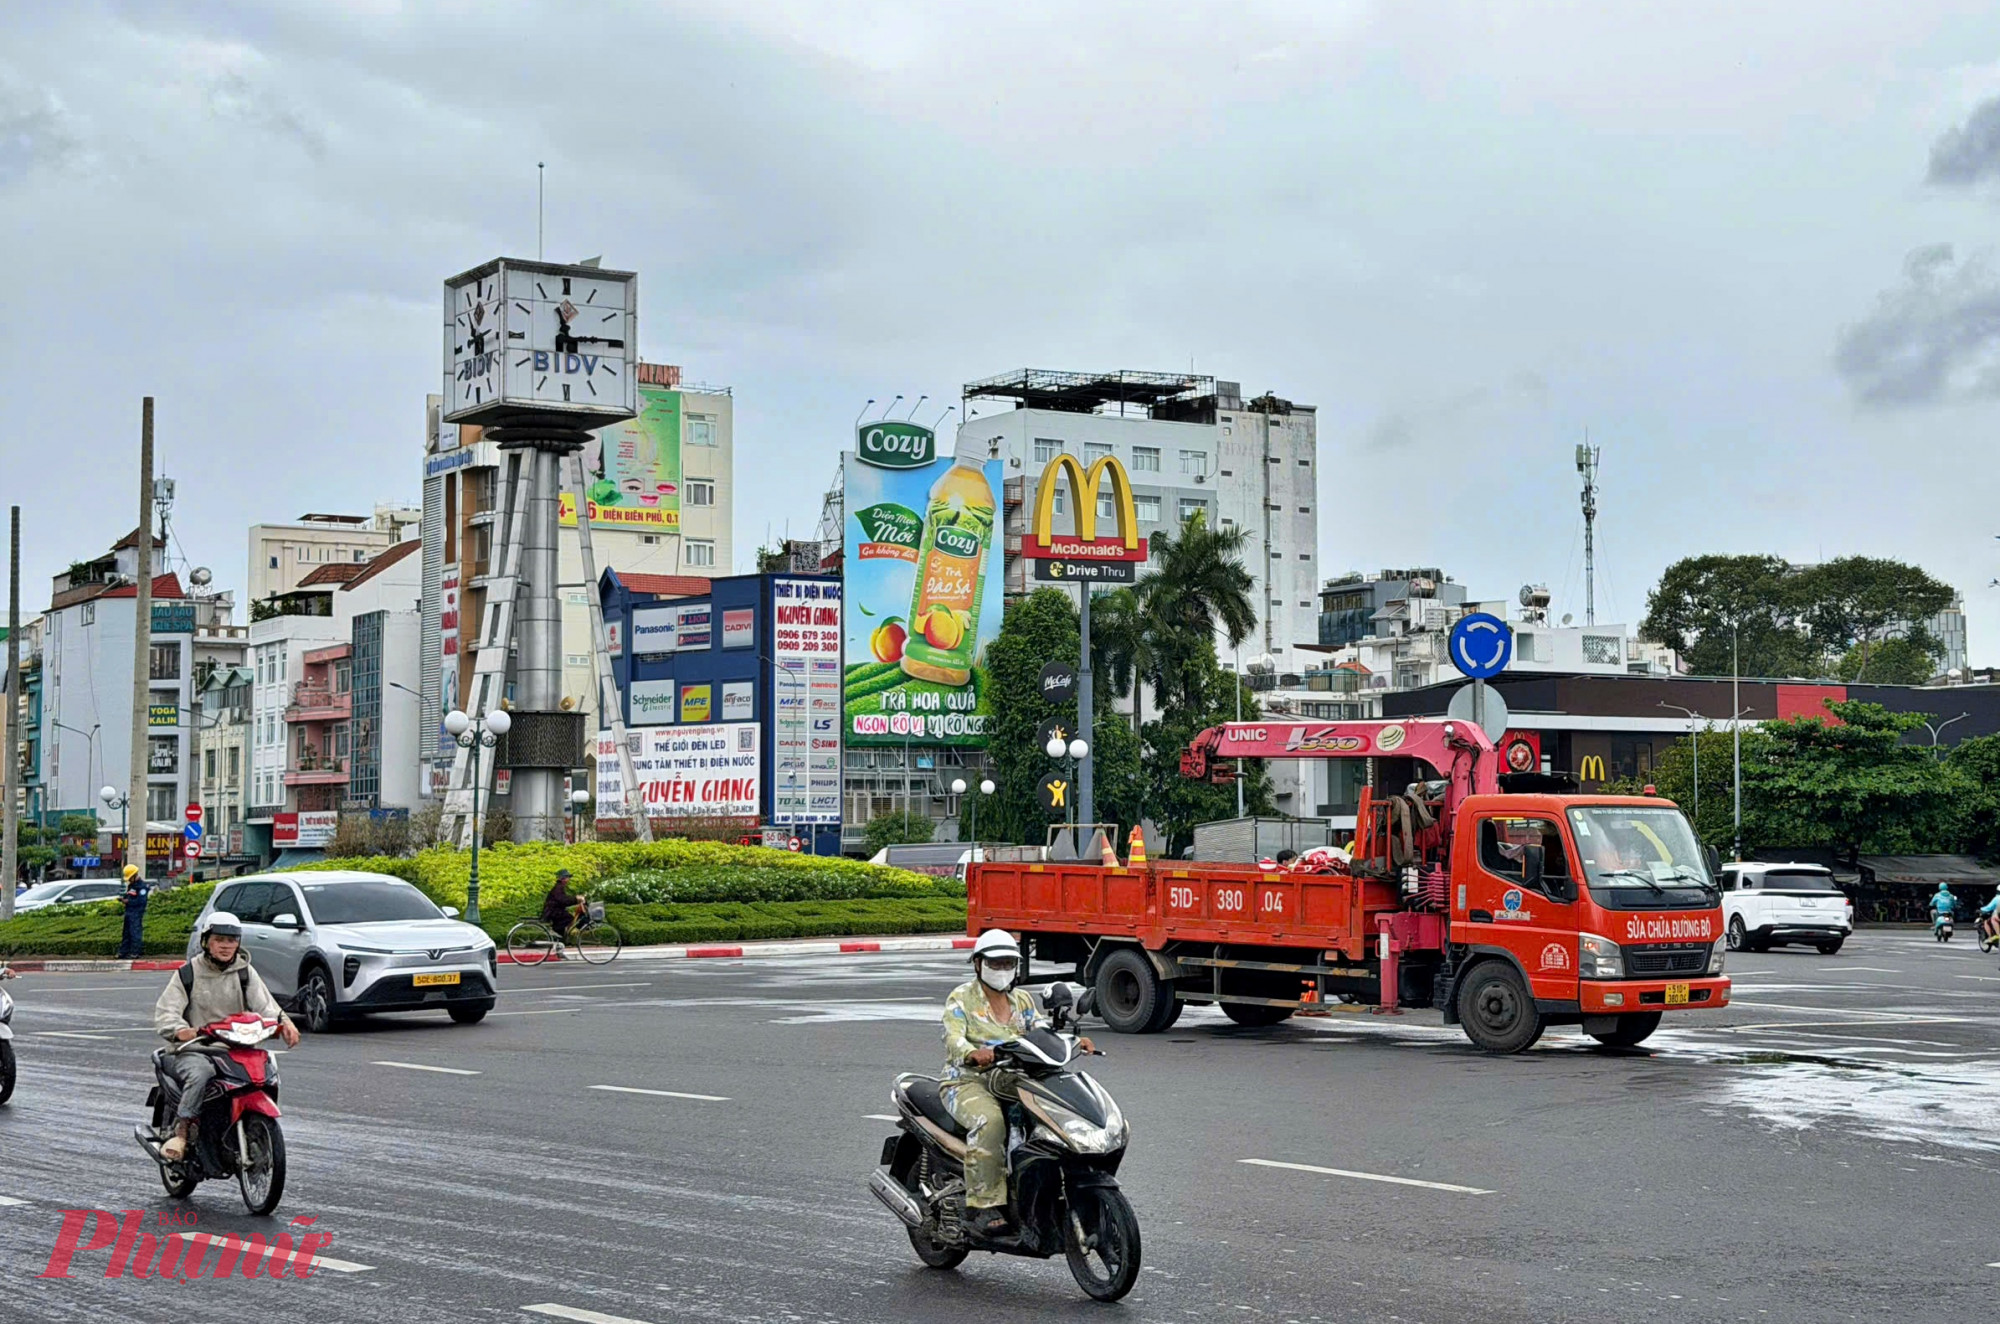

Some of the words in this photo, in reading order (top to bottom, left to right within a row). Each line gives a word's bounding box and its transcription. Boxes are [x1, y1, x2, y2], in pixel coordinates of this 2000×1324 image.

[464, 351, 494, 381] BIDV
[534, 351, 599, 376] BIDV
[866, 429, 927, 459] Cozy
[603, 507, 622, 524] ĐIỆN
[625, 509, 643, 521] BIÊN
[666, 511, 678, 523] Q.1
[872, 508, 894, 520] Diện
[874, 521, 916, 543] Mới
[937, 530, 977, 554] Cozy
[1051, 543, 1124, 556] McDonald's
[1067, 565, 1098, 576] Drive
[1101, 566, 1125, 577] Thru
[927, 577, 953, 594] Đào
[814, 607, 838, 626] GIANG
[635, 622, 675, 634] Panasonic
[725, 623, 751, 632] CADIVI
[777, 630, 799, 640] 0906
[802, 631, 818, 640] 679
[821, 631, 838, 641] 300
[777, 640, 799, 651] 0909
[802, 641, 819, 652] 209
[821, 642, 838, 652] 300
[633, 693, 672, 706] Schneider
[684, 697, 707, 706] MPE
[881, 686, 906, 710] TRÀ
[912, 692, 940, 710] HOA
[947, 685, 976, 710] QUẢ
[151, 707, 176, 715] YOGA
[149, 716, 177, 724] KALIN
[814, 719, 834, 730] LS
[856, 716, 887, 733] NGON
[892, 714, 908, 731] RÕ
[1228, 728, 1267, 742] UNIC
[655, 739, 670, 752] THẾ
[692, 738, 708, 751] ĐÈN
[711, 740, 726, 750] LED
[631, 759, 652, 770] RUNG
[674, 754, 697, 770] THIẾT
[710, 756, 730, 770] ĐIỆN
[732, 753, 755, 766] NƯỚC
[625, 772, 696, 804] GUYỄN
[702, 777, 755, 802] GIANG
[778, 797, 806, 806] TOAL
[148, 835, 179, 848] KÍNH
[1170, 887, 1200, 909] 51D-
[1217, 889, 1243, 911] 380
[1627, 915, 1646, 939] SỬA
[1648, 915, 1671, 938] CHỮA
[1672, 915, 1700, 937] ĐƯỜNG
[1701, 916, 1711, 939] BỘ
